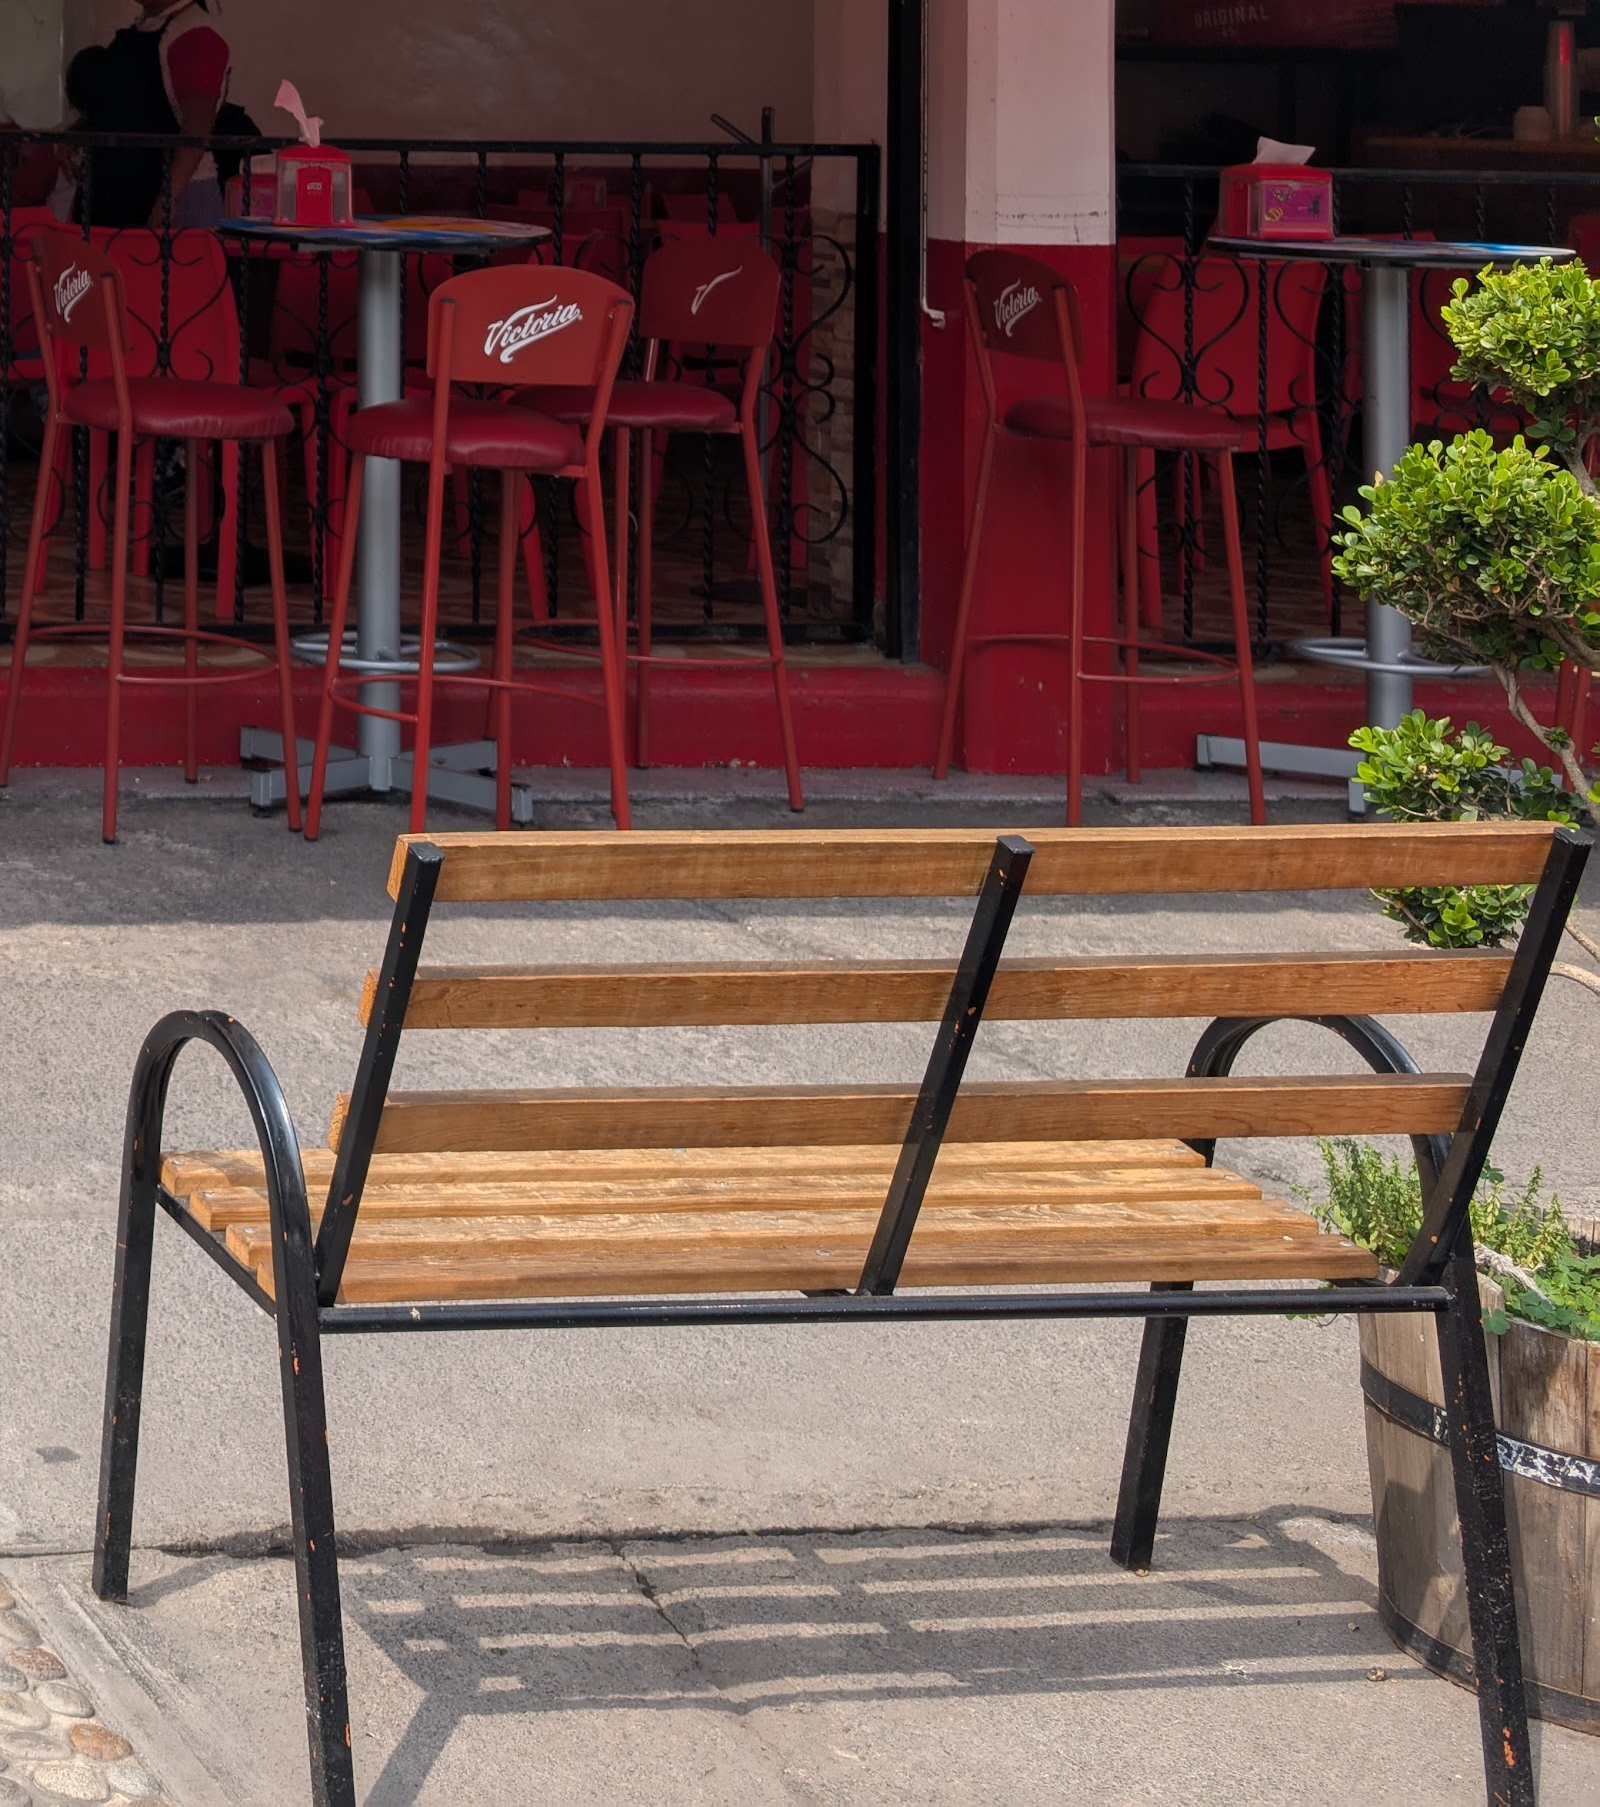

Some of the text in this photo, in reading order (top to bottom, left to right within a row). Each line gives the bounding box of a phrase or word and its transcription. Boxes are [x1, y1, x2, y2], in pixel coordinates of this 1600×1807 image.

[53, 260, 93, 324] Victoria
[993, 278, 1042, 338] Victoria
[483, 294, 583, 364] Victoria
